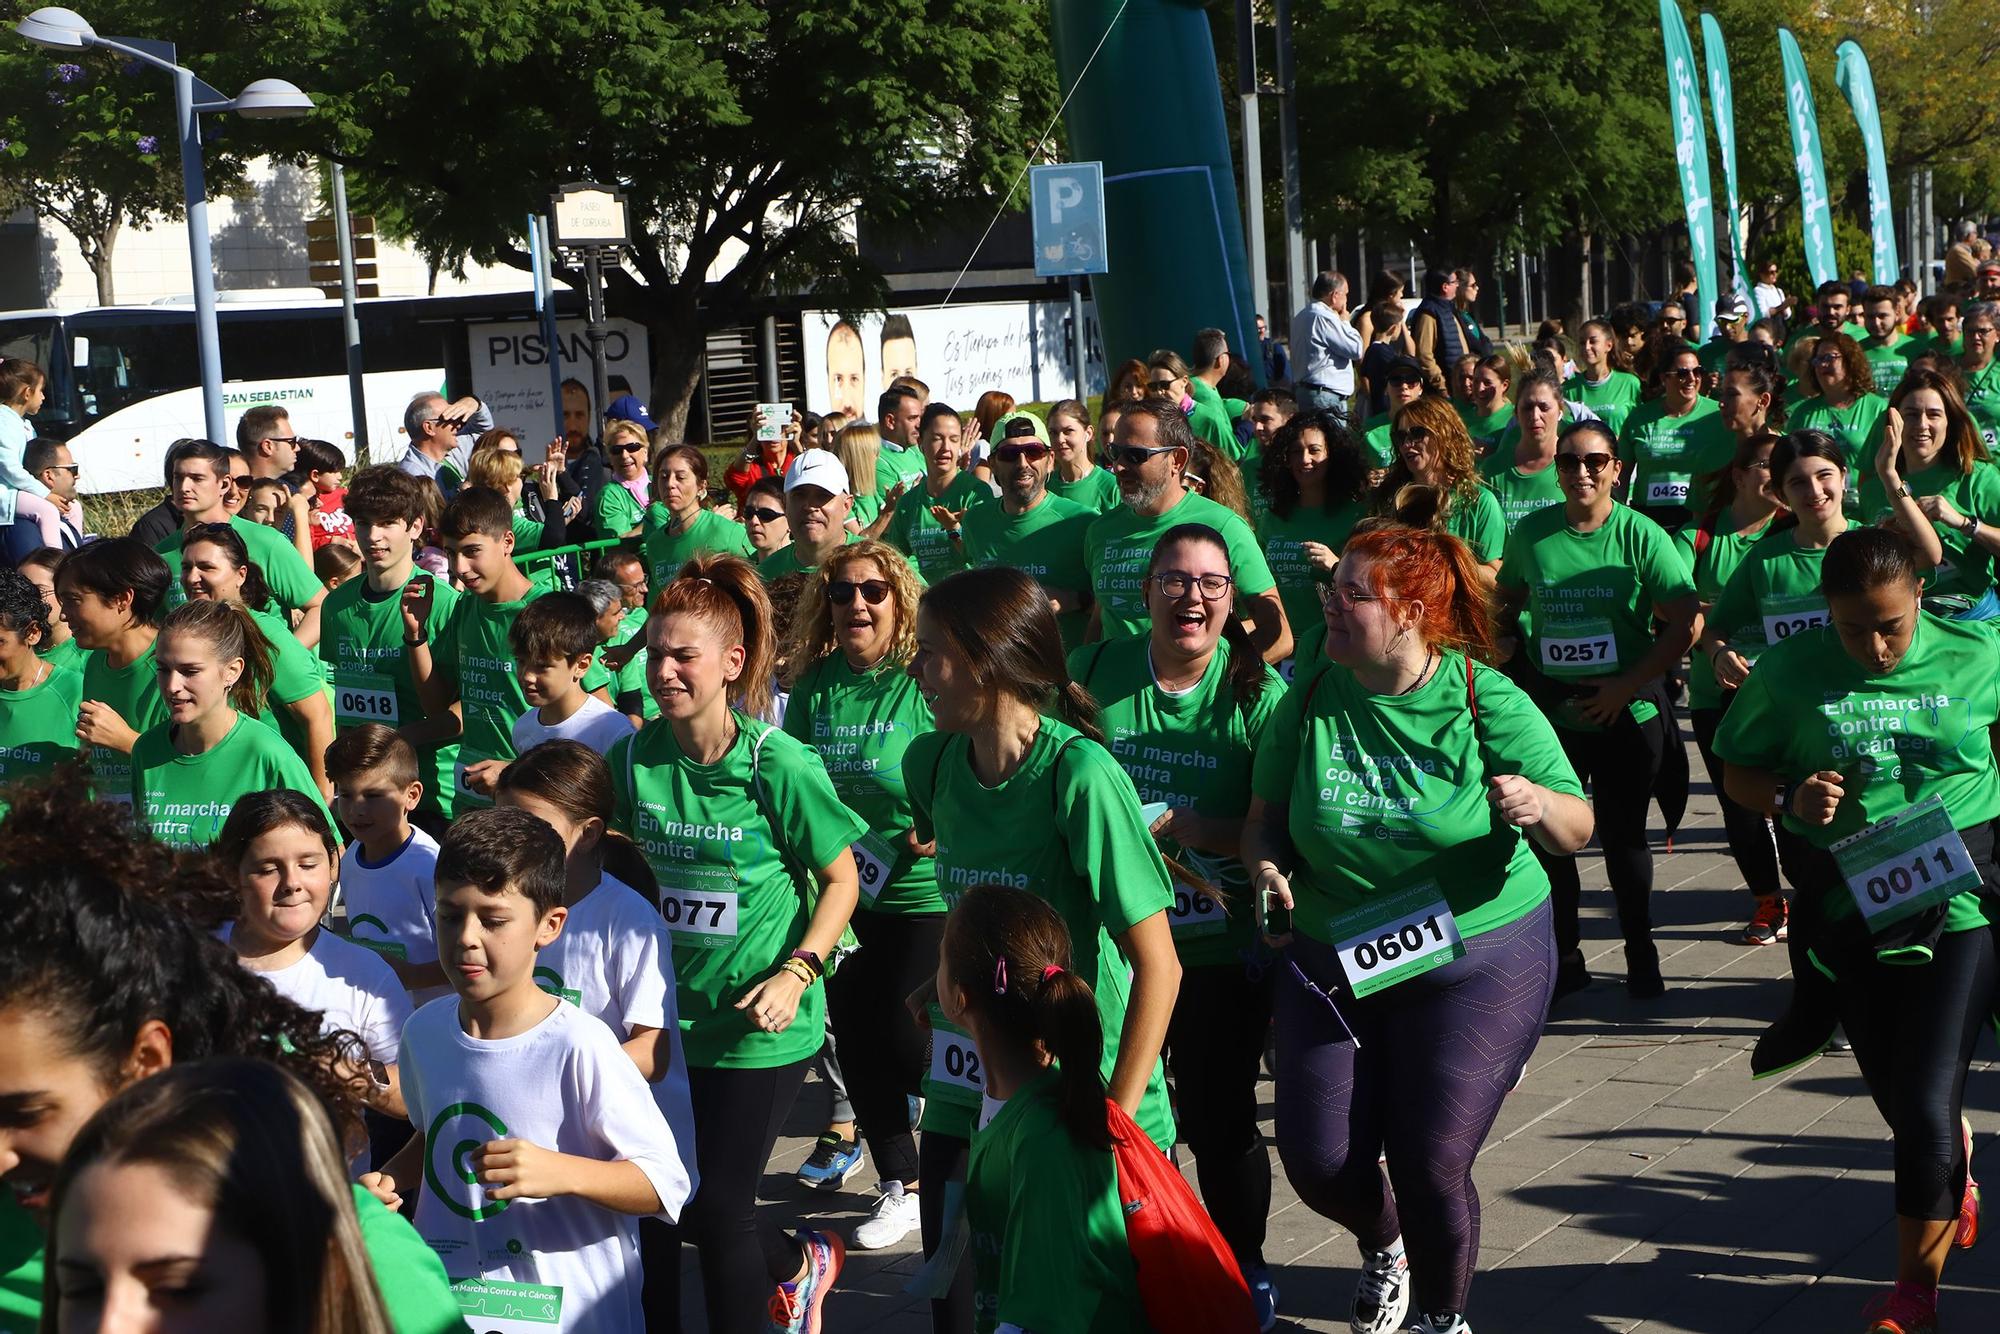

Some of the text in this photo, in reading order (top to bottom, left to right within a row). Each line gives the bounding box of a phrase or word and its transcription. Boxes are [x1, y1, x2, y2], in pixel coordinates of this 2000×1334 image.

[1048, 177, 1083, 224] P
[488, 332, 630, 367] PISANO
[223, 388, 314, 405] SAN SEBASTIAN
[1652, 485, 1688, 497] 0429
[1104, 547, 1118, 560] En
[1100, 562, 1140, 573] contra
[1097, 576, 1107, 589] el
[1536, 585, 1614, 598] En marcha
[1541, 600, 1584, 612] contra
[338, 643, 401, 658] En marcha
[1549, 640, 1609, 662] 0257
[342, 692, 393, 716] 0618
[1824, 693, 1950, 716] En marcha
[814, 719, 895, 737] En marcha
[1828, 714, 1901, 737] contra
[0, 746, 42, 763] archa
[1111, 736, 1218, 769] En marcha
[1330, 742, 1436, 773] En marcha
[1831, 735, 1936, 759] el cáncer
[825, 757, 880, 774] cáncer
[1325, 766, 1392, 790] contra
[163, 800, 232, 818] marcha
[1320, 785, 1419, 811] el cáncer
[638, 811, 744, 841] En marcha
[950, 867, 1029, 890] marcha
[1866, 846, 1955, 904] 0011
[662, 896, 727, 928] 077
[1353, 914, 1444, 970] 0601
[945, 1044, 981, 1085] 02
[459, 1284, 489, 1294] Marcha
[489, 1286, 518, 1298] Contra
[518, 1288, 528, 1298] el
[528, 1289, 559, 1301] Cáncer
